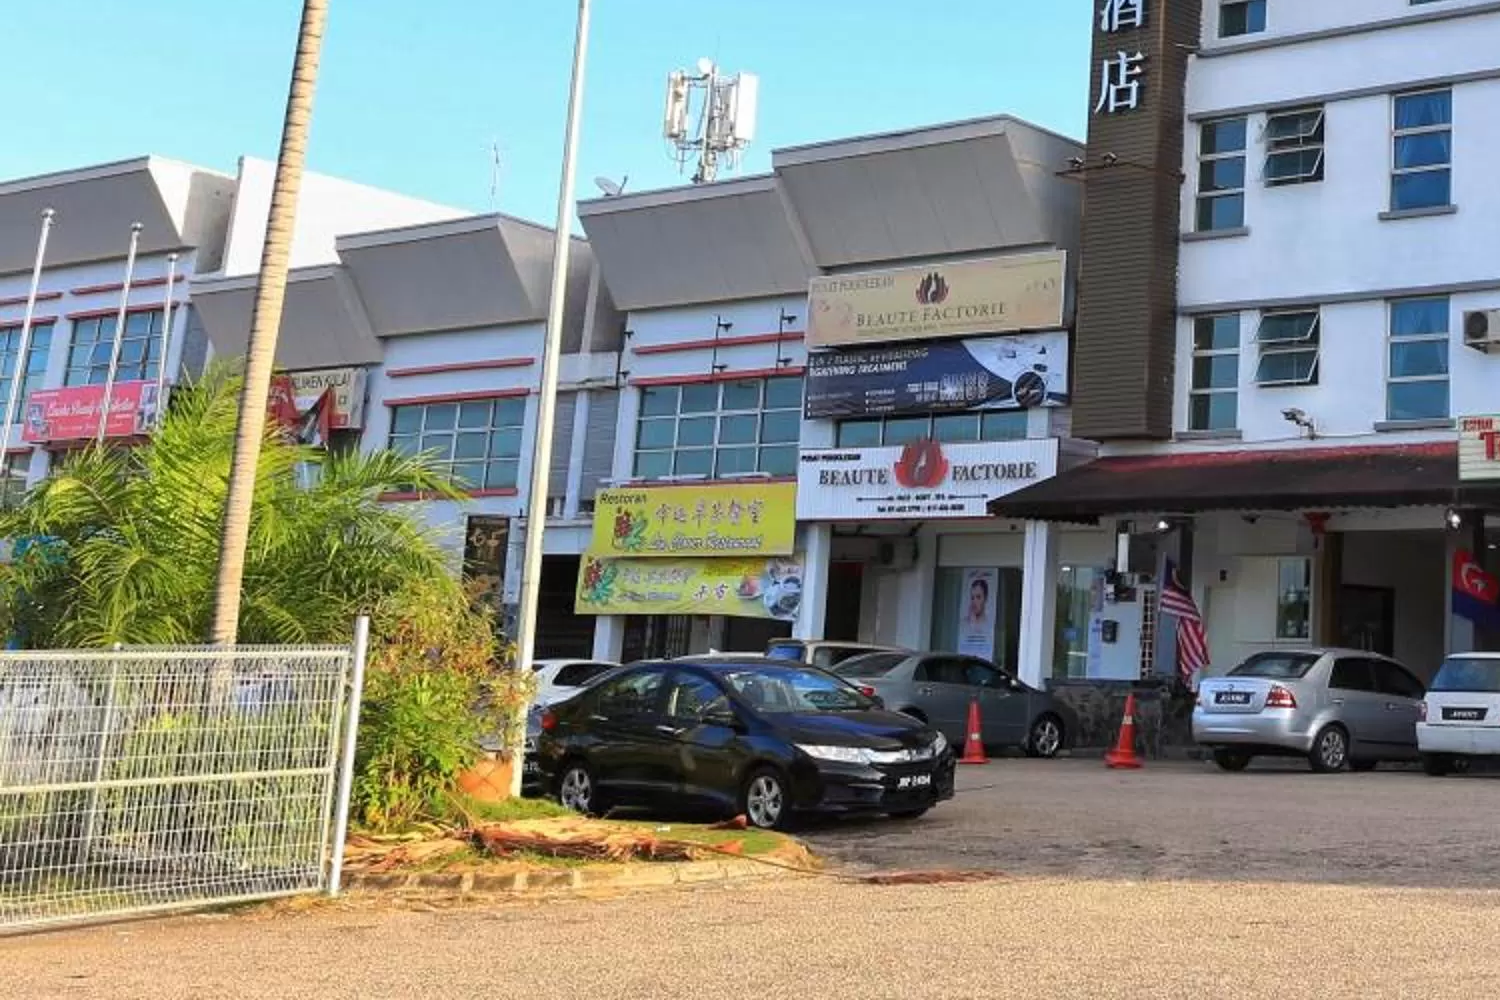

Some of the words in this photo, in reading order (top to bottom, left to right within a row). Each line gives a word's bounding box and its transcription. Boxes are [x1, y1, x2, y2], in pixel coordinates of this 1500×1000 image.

[856, 311, 918, 327] BEAUTE
[818, 466, 889, 486] BEAUTE
[951, 461, 1038, 481] FACTORIE
[600, 493, 647, 505] Restoran
